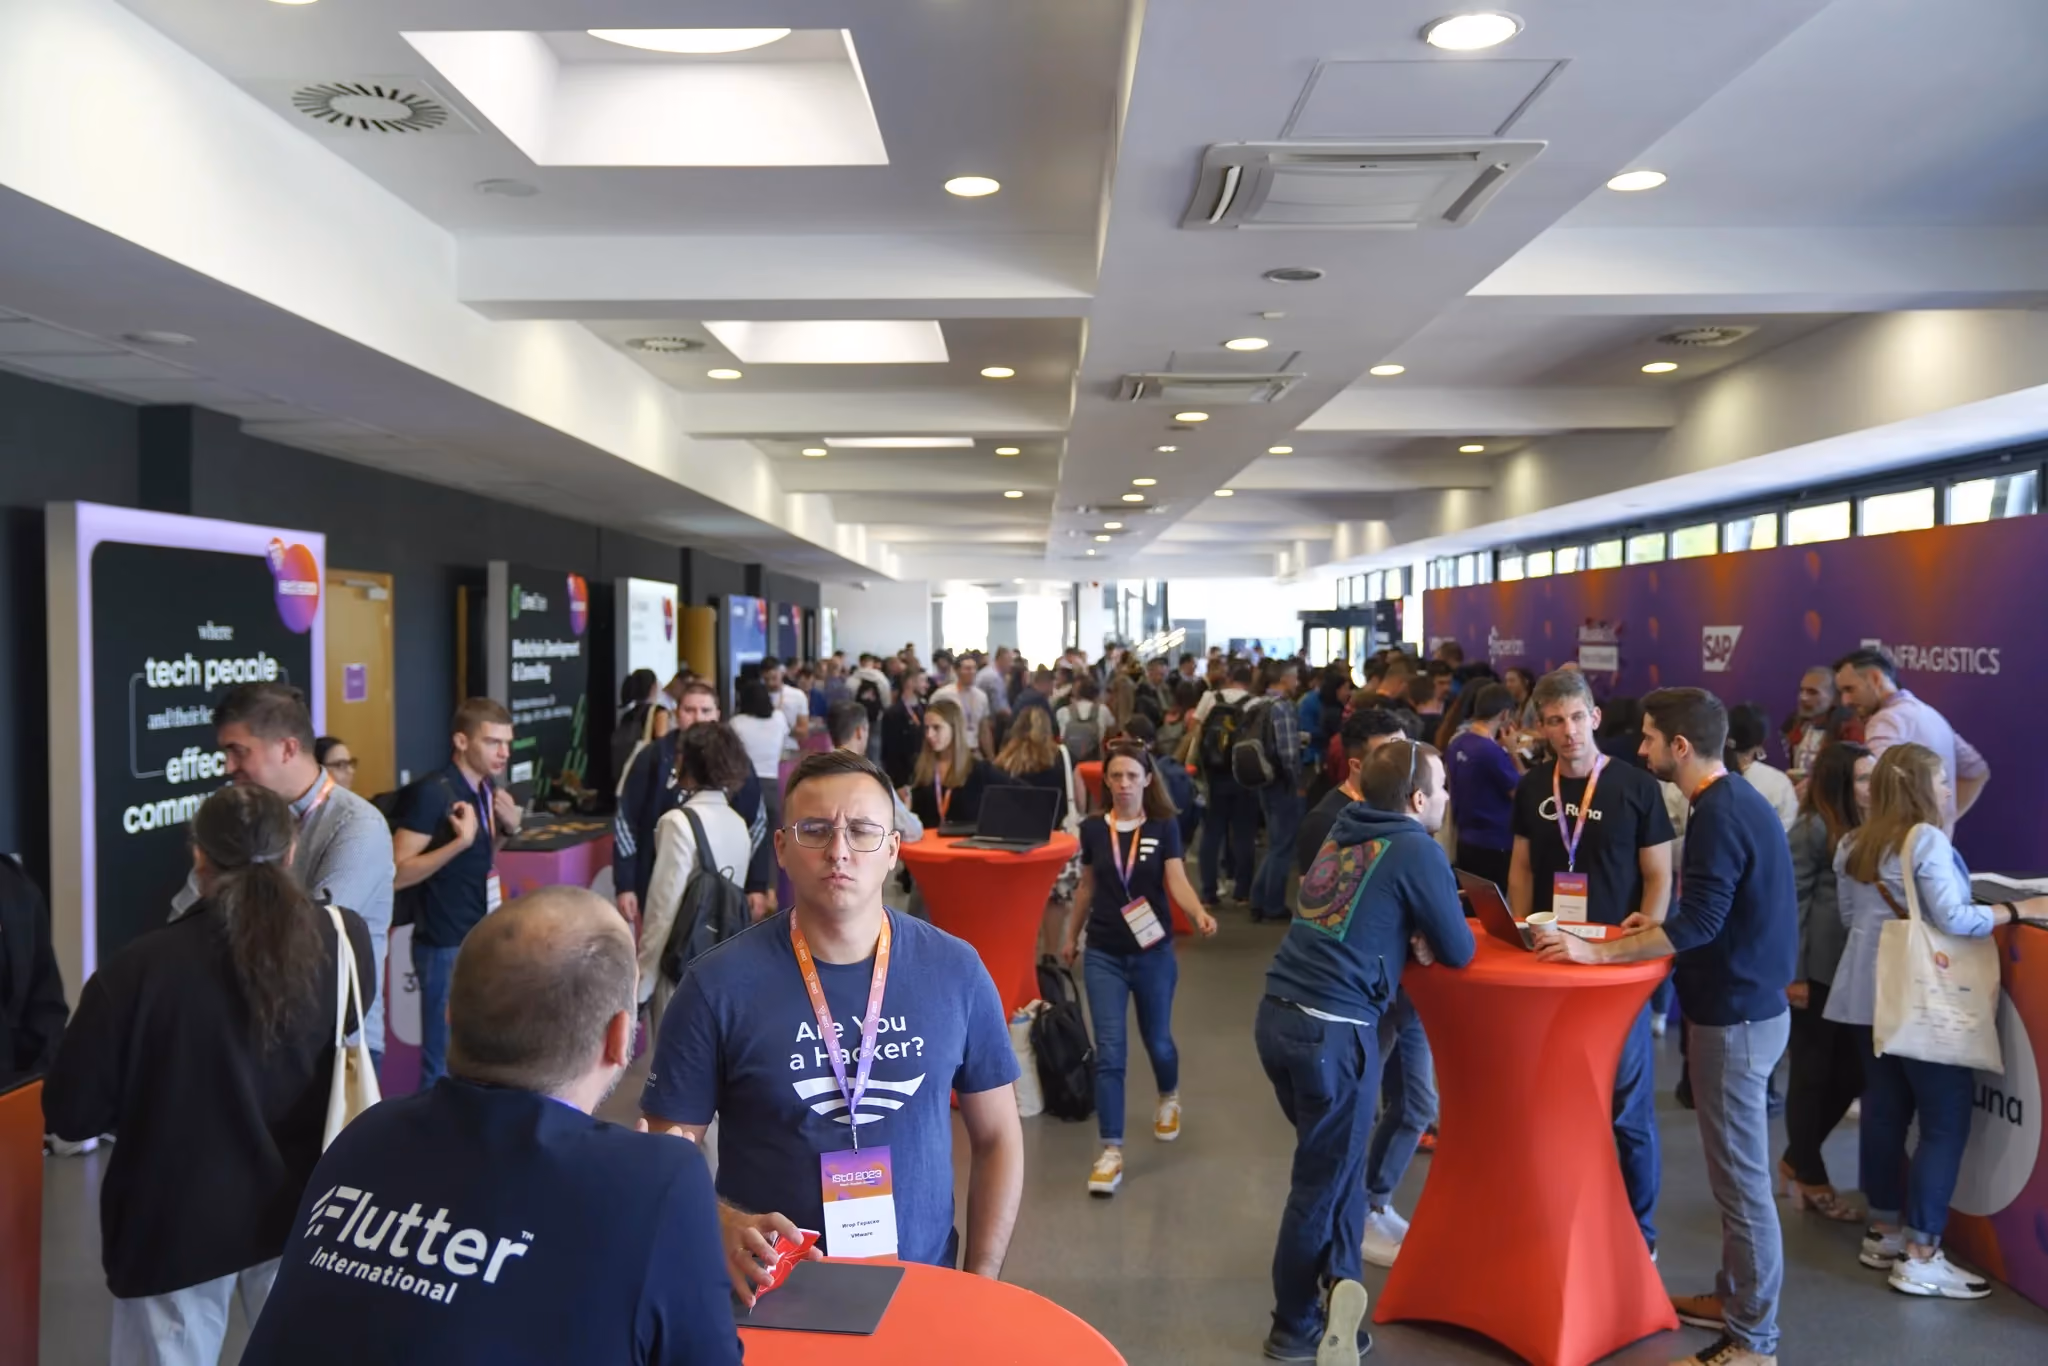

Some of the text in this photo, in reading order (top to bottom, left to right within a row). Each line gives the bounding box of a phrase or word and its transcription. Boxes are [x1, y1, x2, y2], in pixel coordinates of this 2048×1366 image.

[145, 650, 279, 692] tech people
[1881, 644, 2000, 675] NFRAGISTICS
[123, 792, 205, 834] comm
[796, 1020, 845, 1042] Are
[851, 1015, 907, 1035] You
[789, 1052, 805, 1071] a
[814, 1036, 924, 1068] Hacker?
[855, 1169, 882, 1180] 2023
[304, 1184, 529, 1284] Flutter
[309, 1246, 459, 1304] International
